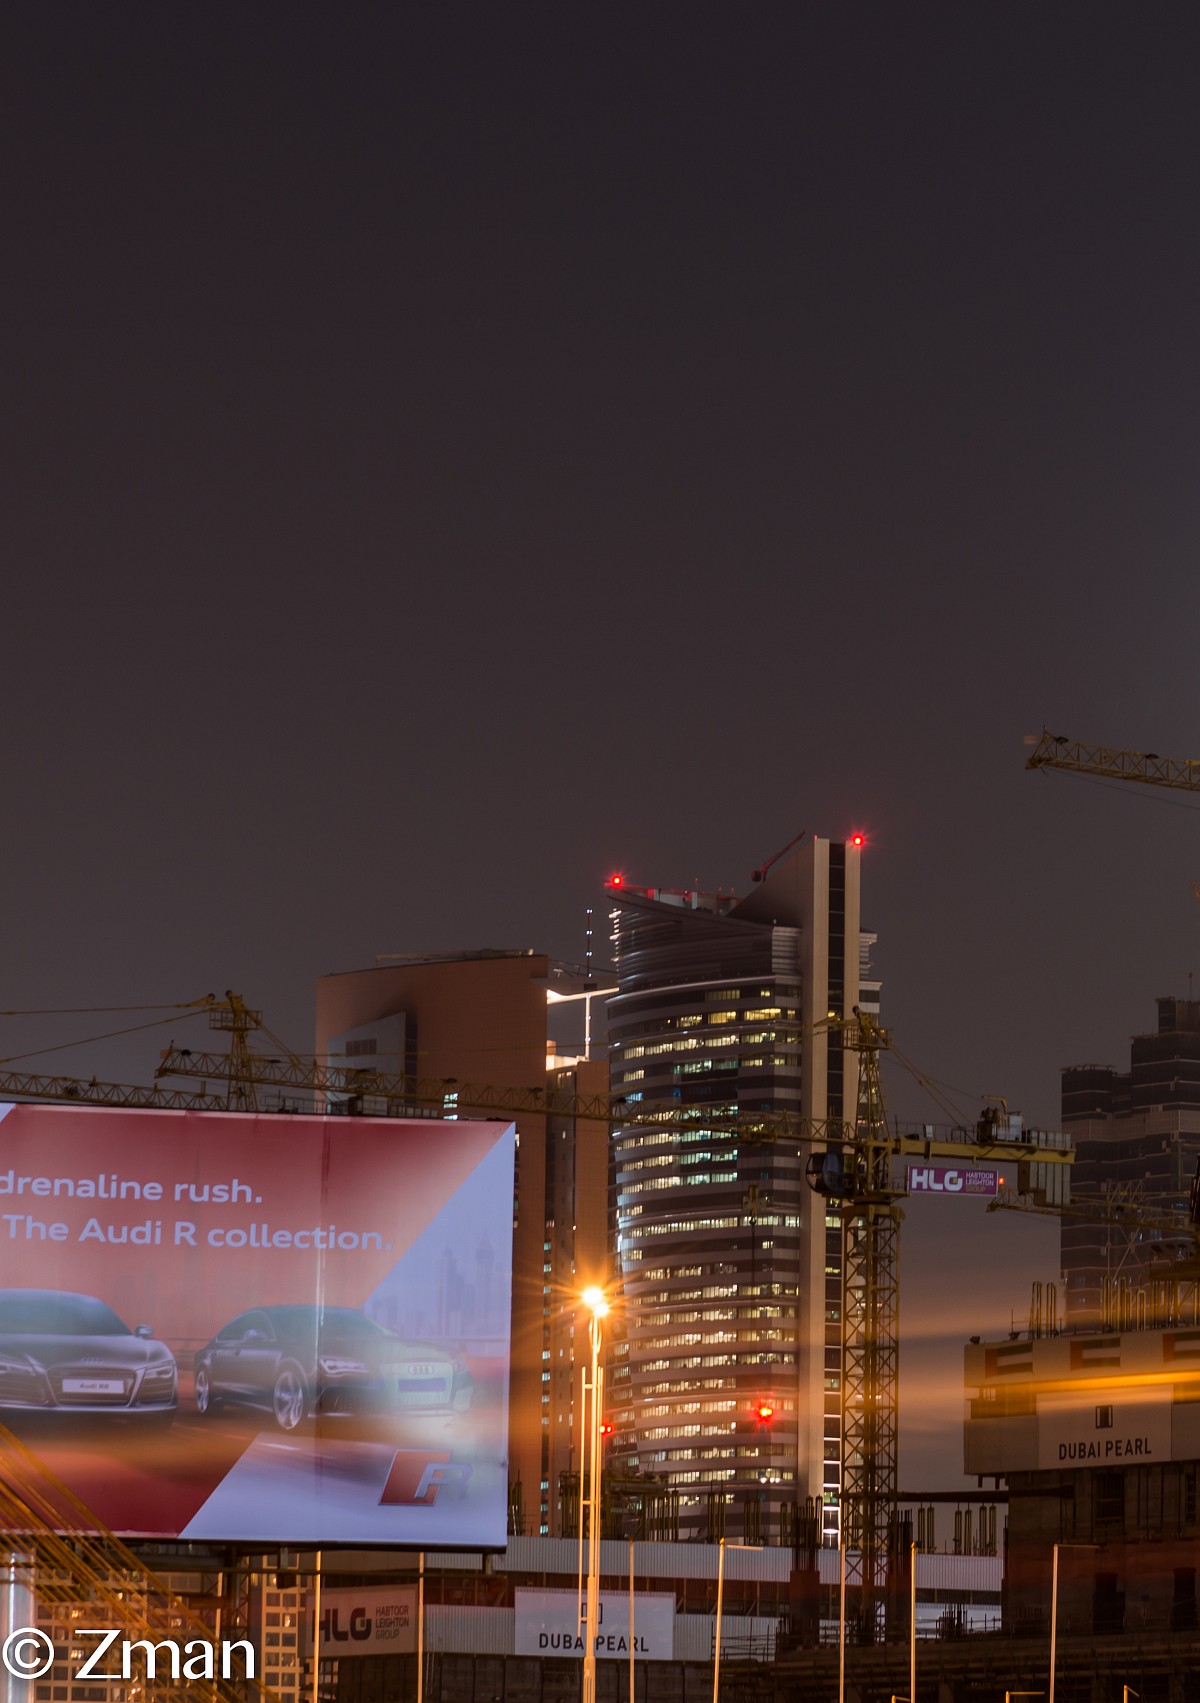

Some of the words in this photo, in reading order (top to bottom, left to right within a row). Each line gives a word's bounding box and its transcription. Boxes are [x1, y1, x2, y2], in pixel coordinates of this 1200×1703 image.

[911, 1168, 963, 1191] HLG
[174, 1179, 263, 1204] rush.
[3, 1214, 69, 1241] The
[78, 1218, 161, 1245] Audi
[174, 1221, 197, 1246] R
[207, 1224, 393, 1250] collection.
[1059, 1441, 1100, 1461] DUBAI
[1105, 1437, 1152, 1458] PEARL
[375, 1605, 409, 1616] HABTOOR
[312, 1607, 372, 1642] HLG
[375, 1617, 409, 1629] LEIGHTON
[539, 1633, 589, 1650] DUBA
[596, 1635, 649, 1652] PEARL
